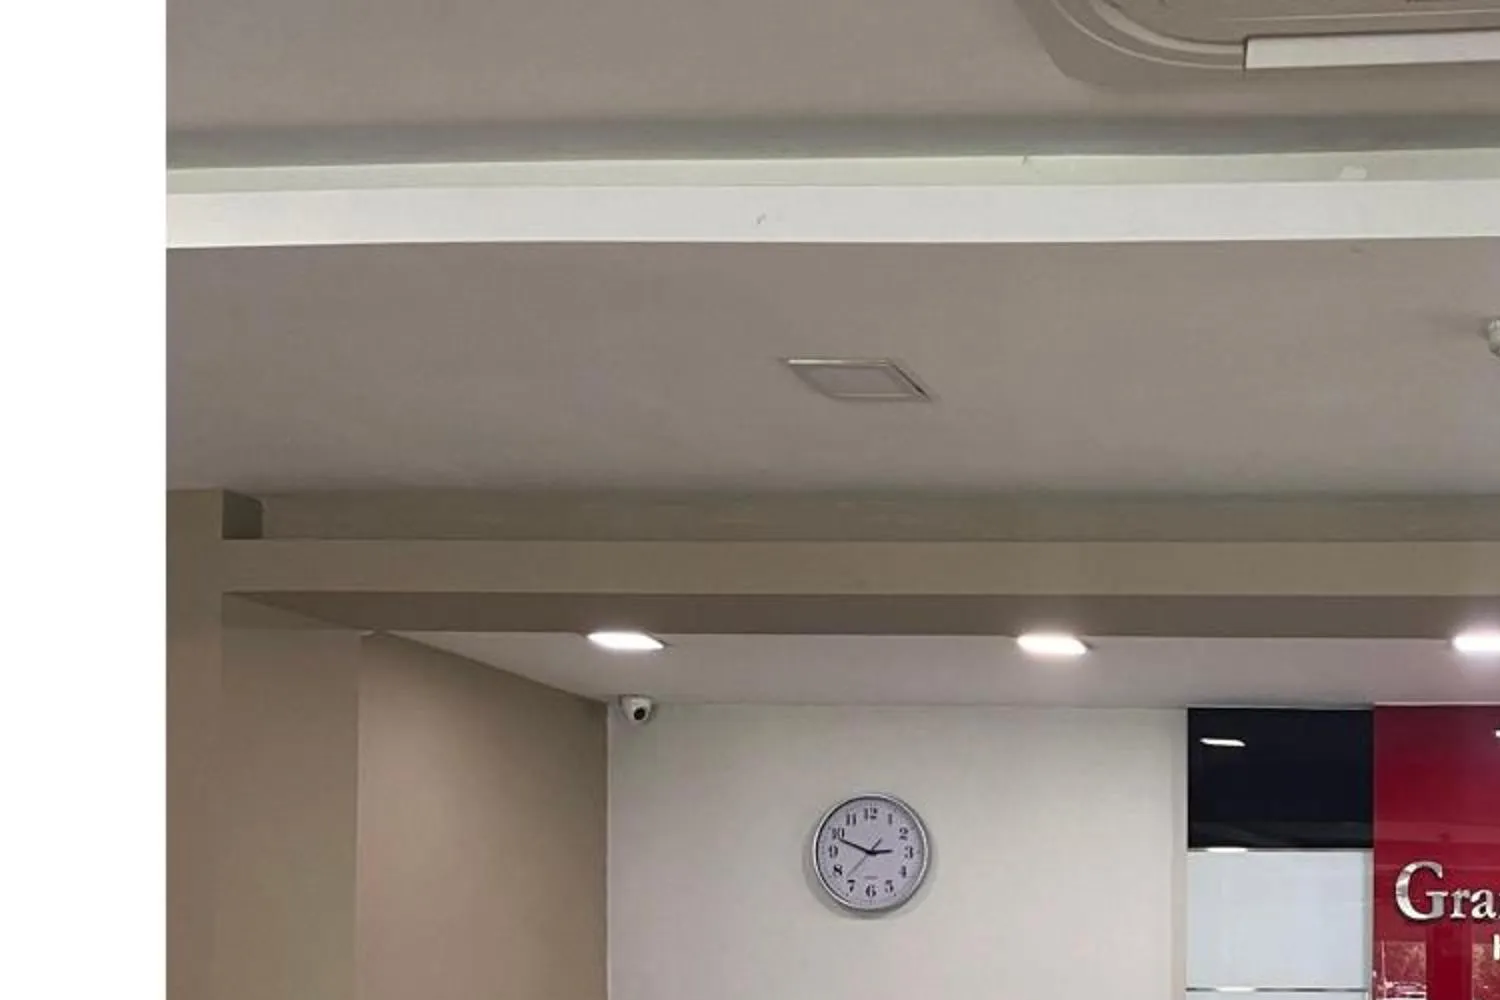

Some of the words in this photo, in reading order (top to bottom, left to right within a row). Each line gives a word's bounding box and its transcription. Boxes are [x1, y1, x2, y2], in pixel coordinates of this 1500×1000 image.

[846, 813, 857, 826] 11
[864, 808, 877, 819] 12
[832, 827, 845, 839] 10
[899, 827, 909, 840] 2
[829, 845, 838, 858] 9
[904, 846, 914, 858] 3
[832, 864, 843, 876] 8
[847, 879, 856, 892] 7
[865, 884, 877, 897] 6
[884, 879, 894, 893] 5
